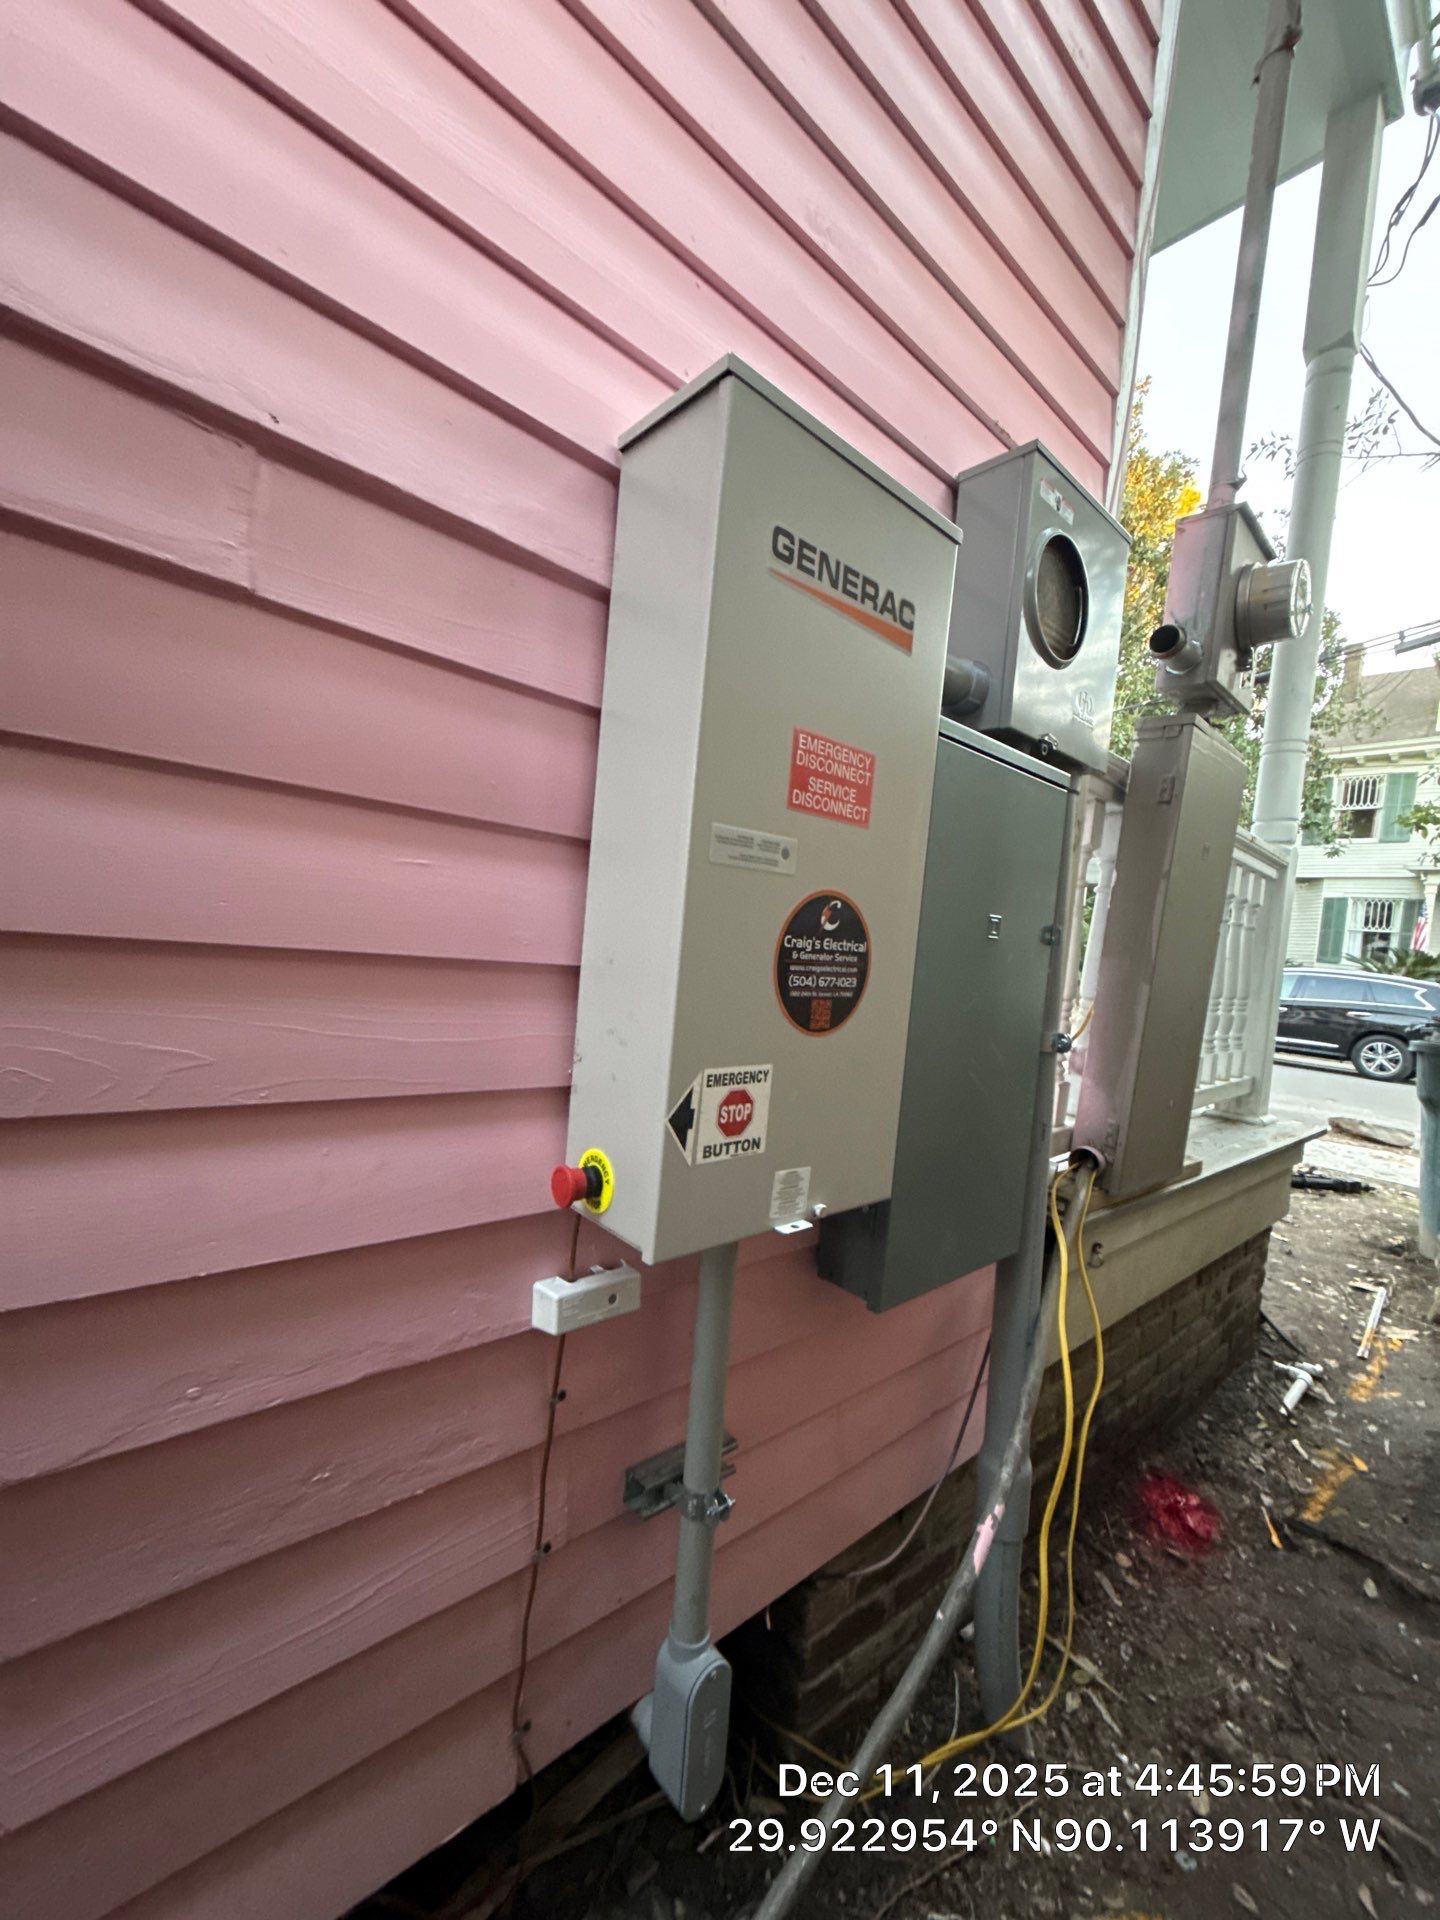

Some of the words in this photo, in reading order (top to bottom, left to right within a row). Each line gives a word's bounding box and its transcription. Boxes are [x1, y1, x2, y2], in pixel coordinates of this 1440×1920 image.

[771, 525, 916, 631] GENERAC
[798, 733, 872, 770] EMERGENCY
[796, 750, 872, 786] DISCONNECT
[807, 776, 857, 803] SERVICE
[792, 788, 868, 821] DISCONNECT
[783, 935, 821, 952] Craig's
[823, 937, 867, 953] Electrical
[792, 950, 798, 960] &
[799, 951, 834, 961] Generator
[788, 974, 817, 988] (504)
[818, 975, 858, 988] 677-1023
[706, 1069, 770, 1088] EMERGENCY
[720, 1103, 752, 1124] STOP
[702, 1137, 762, 1159] BUTTON
